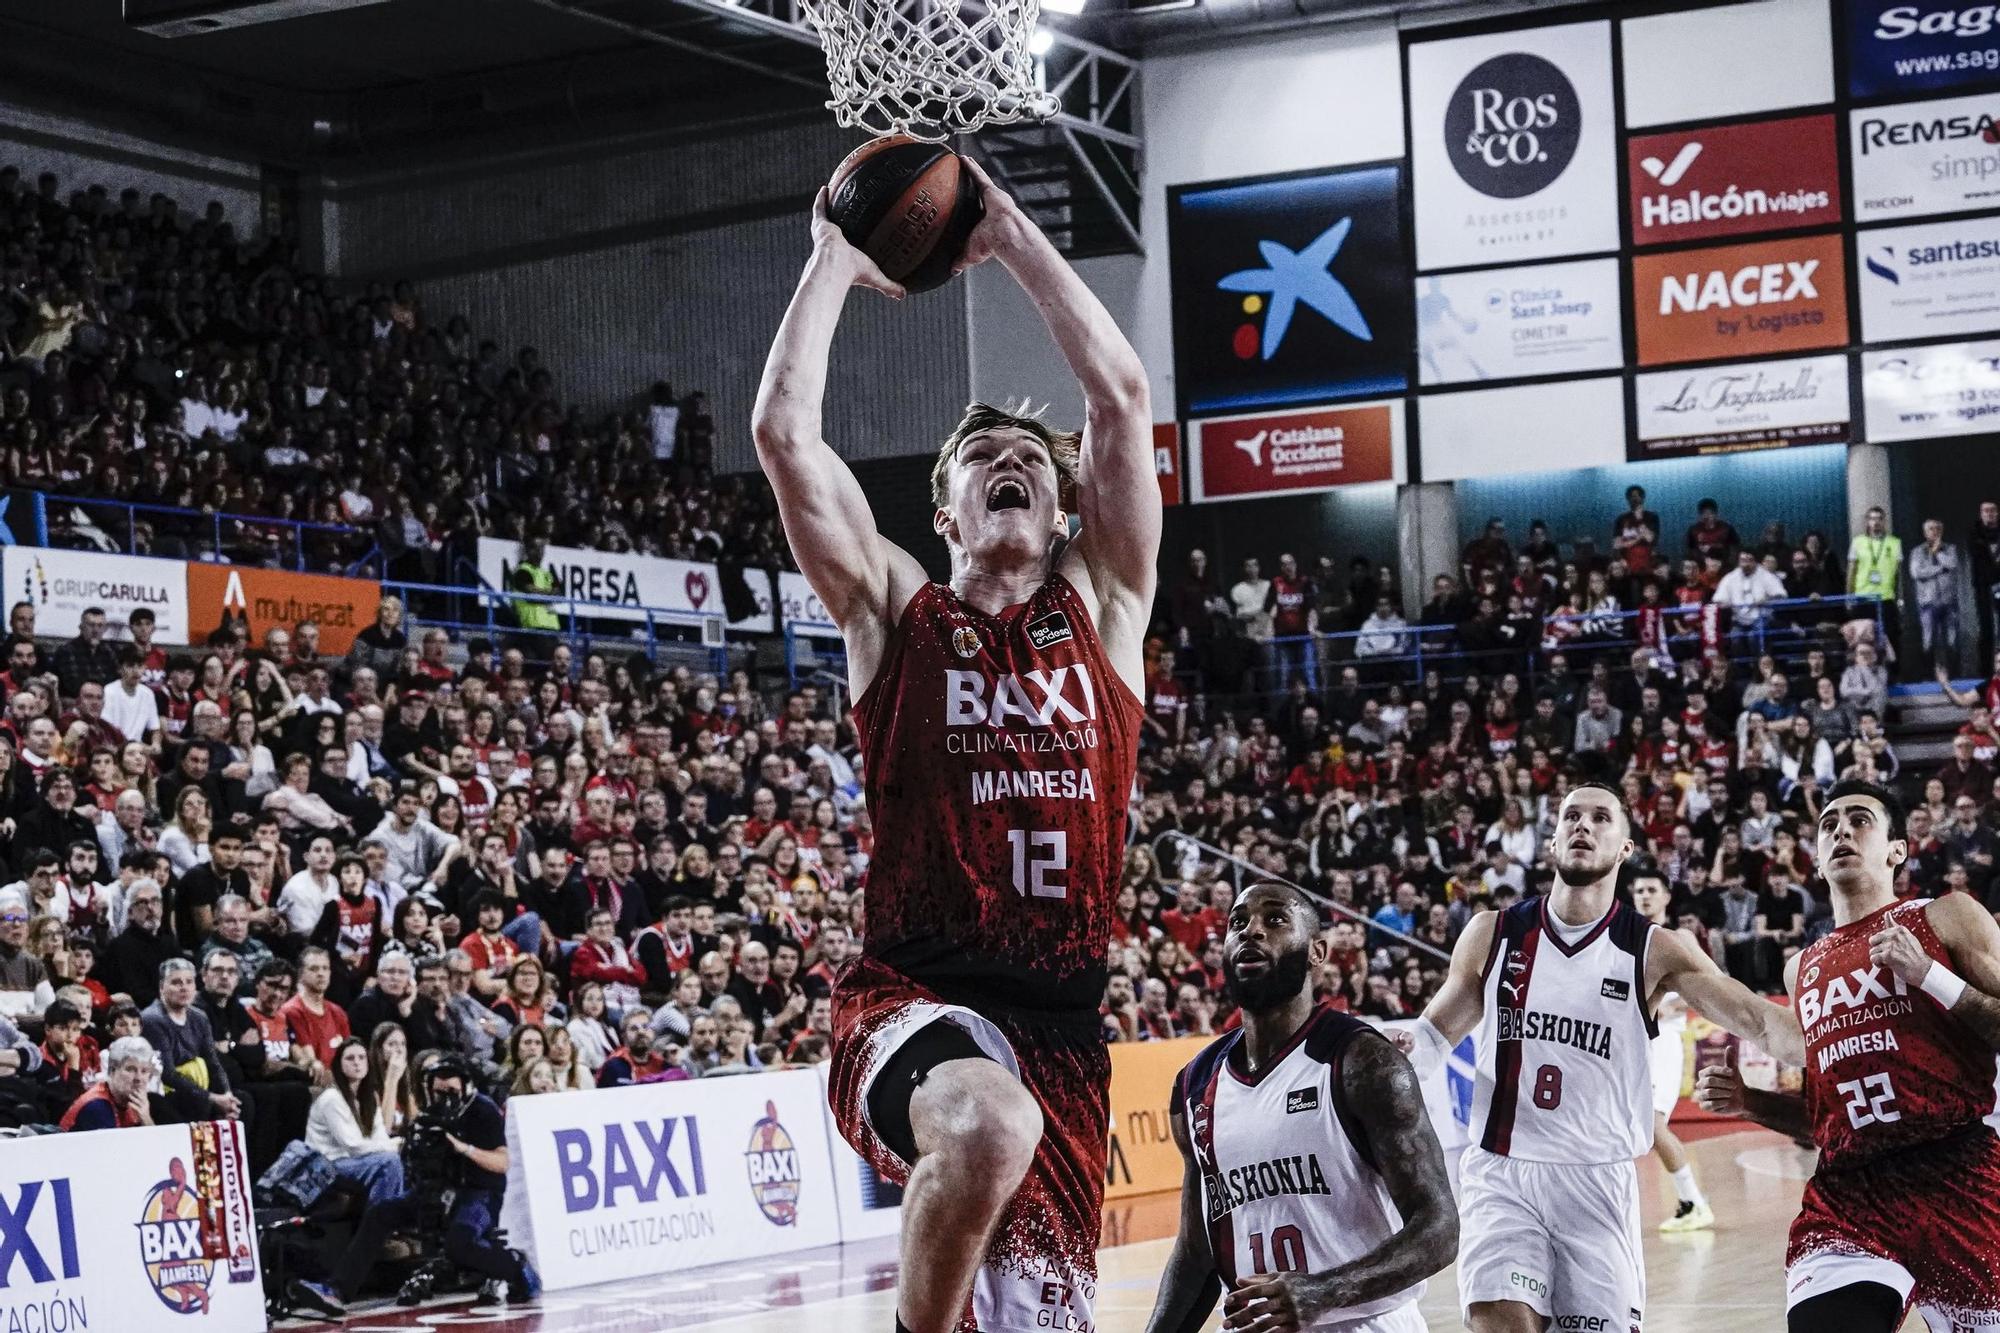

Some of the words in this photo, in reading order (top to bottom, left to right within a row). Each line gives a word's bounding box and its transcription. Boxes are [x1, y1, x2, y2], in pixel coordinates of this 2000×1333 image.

[1874, 5, 2000, 40] Sag
[1894, 48, 2000, 76] www.sag
[1659, 258, 1820, 316] NACEX
[255, 595, 355, 628] mutuacat
[945, 664, 1097, 728] BAXI
[971, 768, 1096, 805] MANRESA
[1007, 829, 1067, 899] 12
[1498, 1006, 1613, 1061] BASKONIA
[1804, 998, 1913, 1049] CLIMATIZACIÓN
[1817, 1028, 1900, 1075] MANRESA
[1533, 1063, 1563, 1111] 8
[1836, 1071, 1902, 1131] 22
[552, 1115, 707, 1214] BAXI
[748, 1150, 800, 1184] BAXI
[1203, 1152, 1332, 1223] BASKONIA
[140, 1219, 204, 1263] BAX
[568, 1202, 716, 1258] CLIMATIZACIÓN
